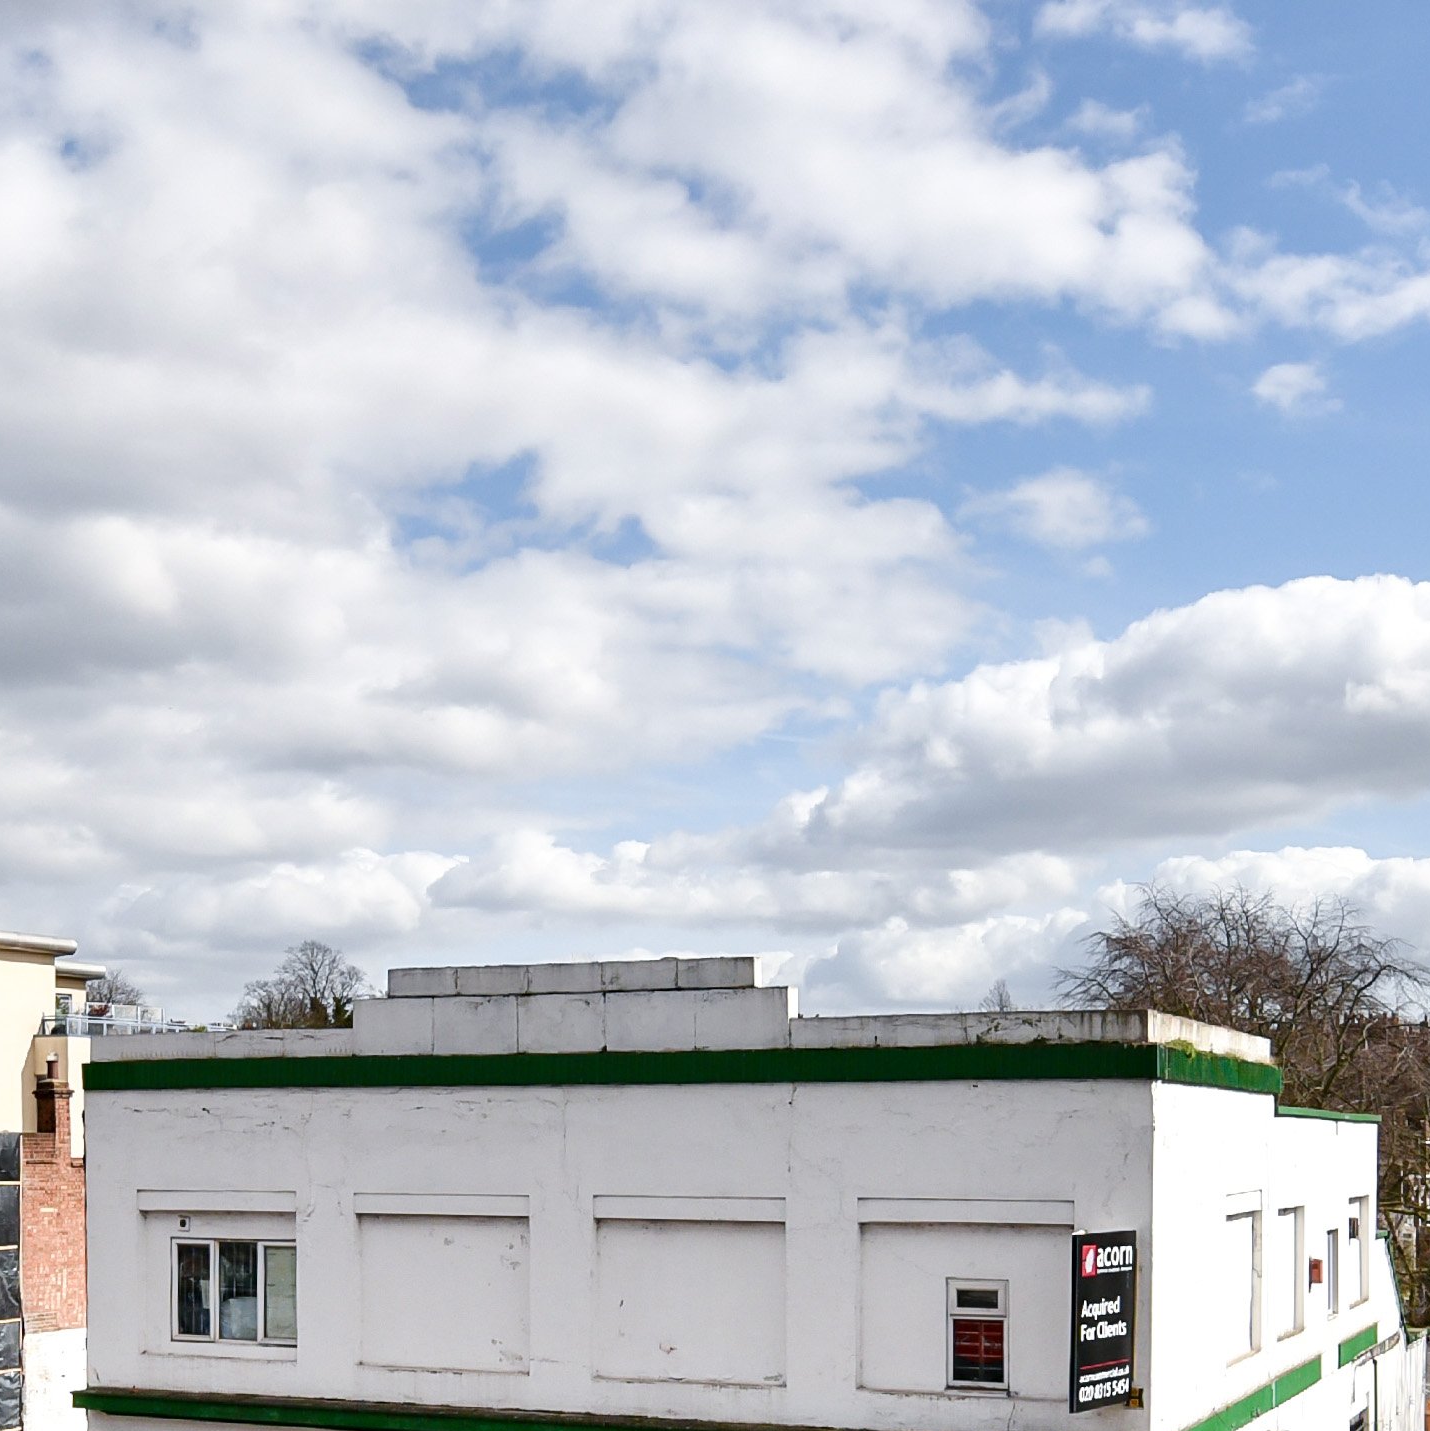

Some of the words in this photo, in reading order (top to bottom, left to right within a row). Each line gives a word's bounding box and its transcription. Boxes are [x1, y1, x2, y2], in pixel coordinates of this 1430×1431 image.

[1096, 1245, 1133, 1268] acorn
[1081, 1295, 1121, 1321] Acquired
[1080, 1323, 1096, 1342] For
[1096, 1319, 1127, 1339] Clients
[1078, 1384, 1095, 1403] 020
